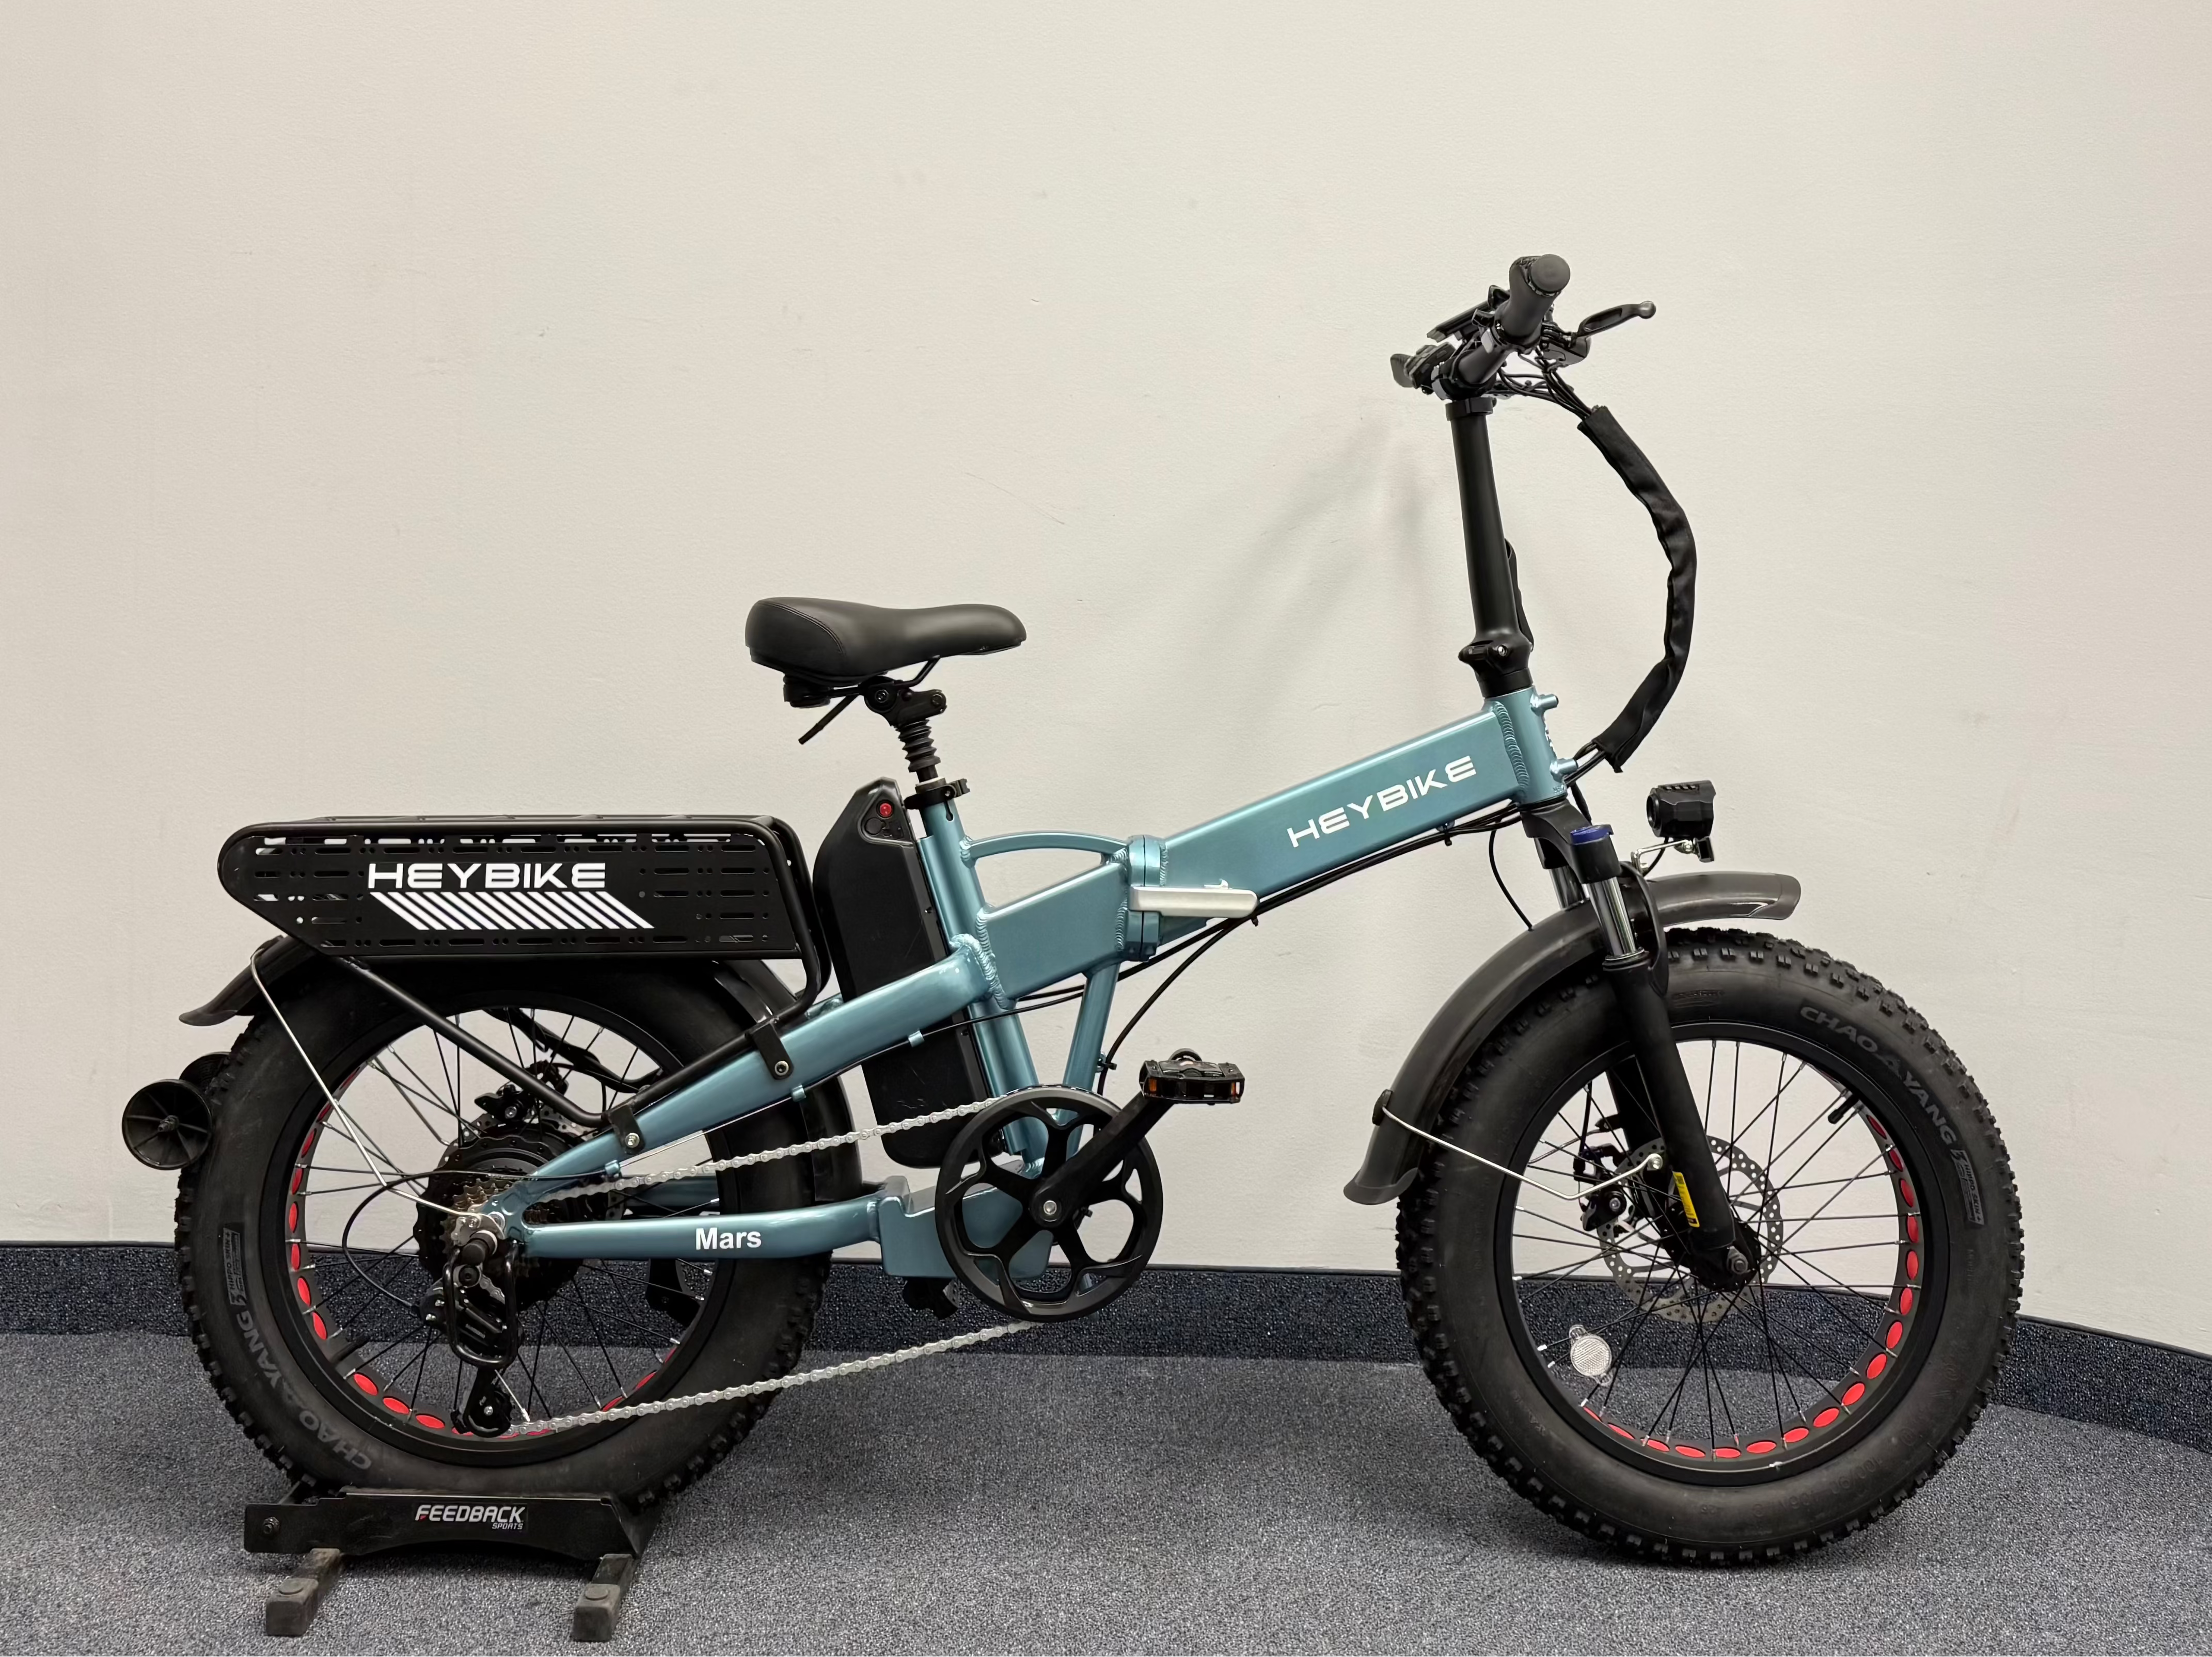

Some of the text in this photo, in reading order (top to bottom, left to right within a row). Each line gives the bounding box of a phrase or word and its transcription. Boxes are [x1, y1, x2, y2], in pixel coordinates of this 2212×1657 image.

[1287, 756, 1476, 848] HEYBIKE
[368, 863, 606, 889] HEYBIKE
[1800, 1007, 1957, 1145] CHAO YANG
[696, 1227, 762, 1250] Mars
[236, 1310, 372, 1470] CHAO YANG
[415, 1504, 526, 1523] FEEDBACK
